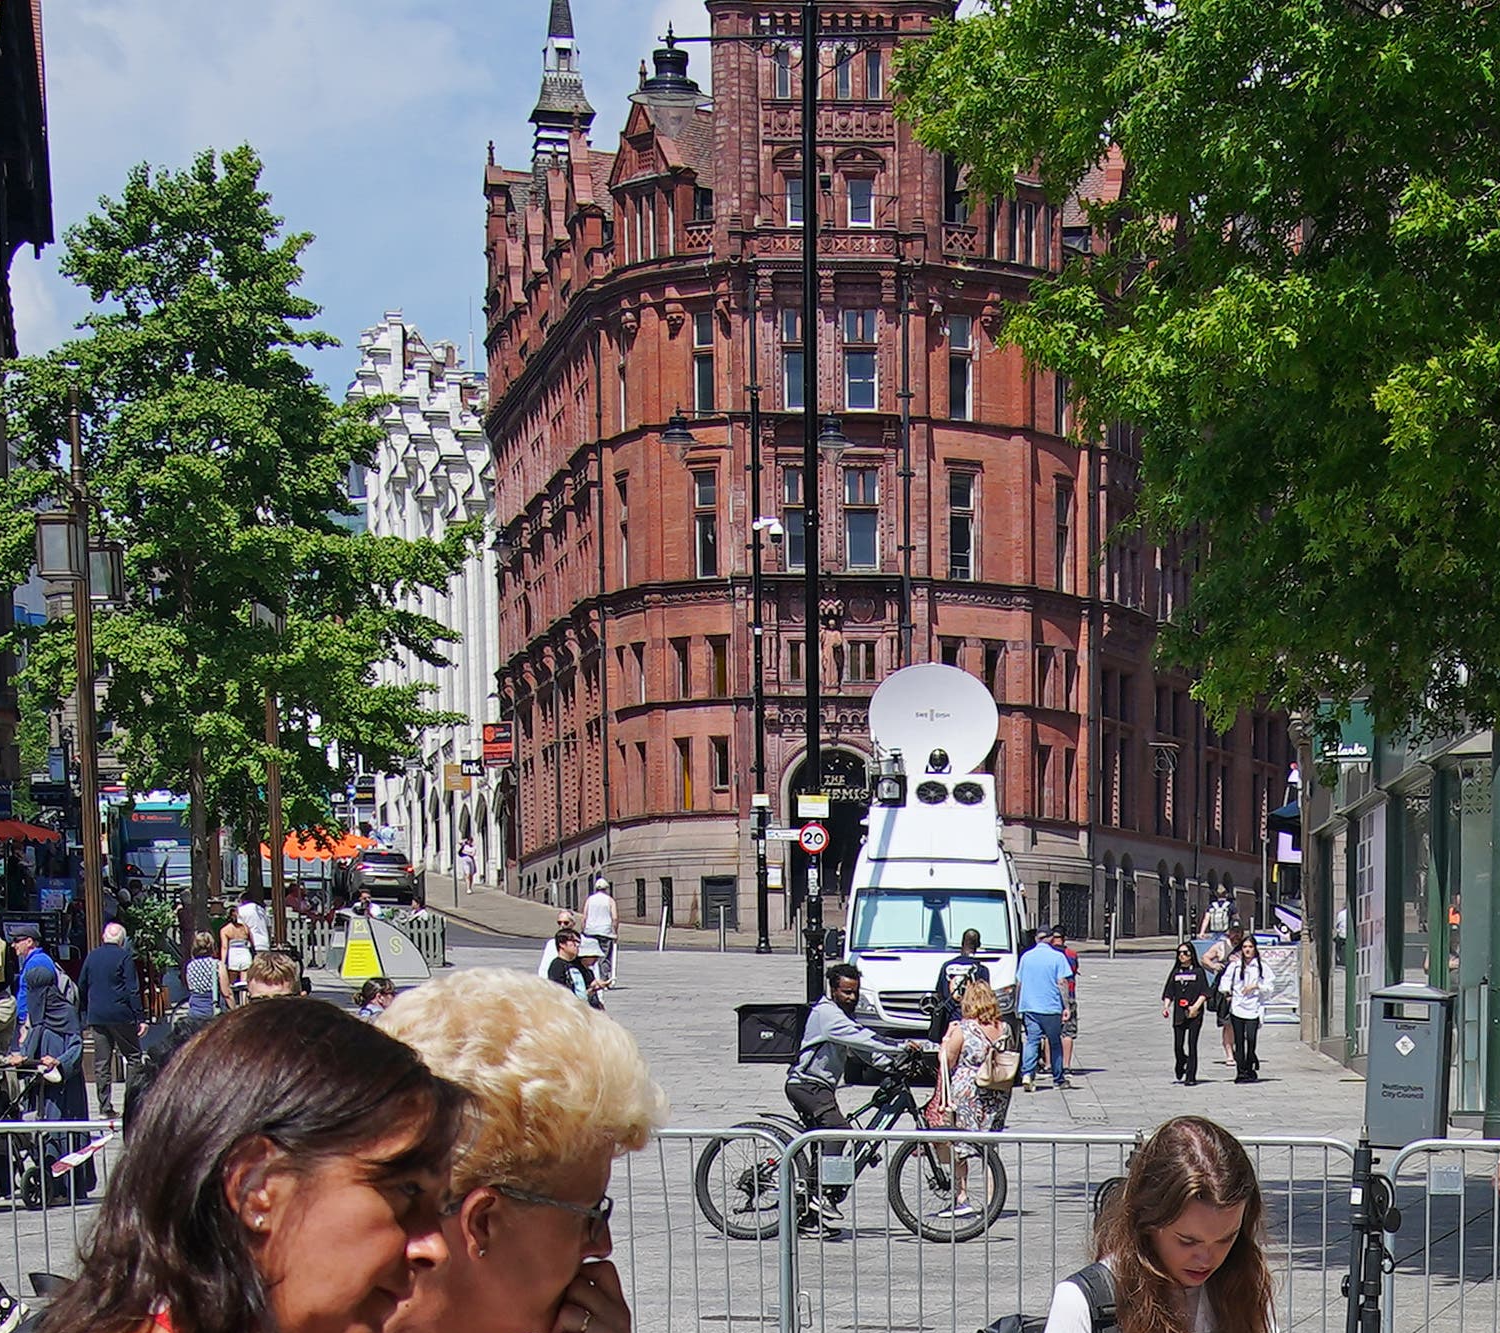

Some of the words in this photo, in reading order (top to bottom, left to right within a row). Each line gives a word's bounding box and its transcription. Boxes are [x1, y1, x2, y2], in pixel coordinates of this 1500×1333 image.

[824, 774, 845, 786] THE
[803, 832, 824, 845] 20
[1395, 1023, 1417, 1031] Litter
[1382, 1083, 1424, 1092] Nottingham
[1381, 1091, 1396, 1099] City
